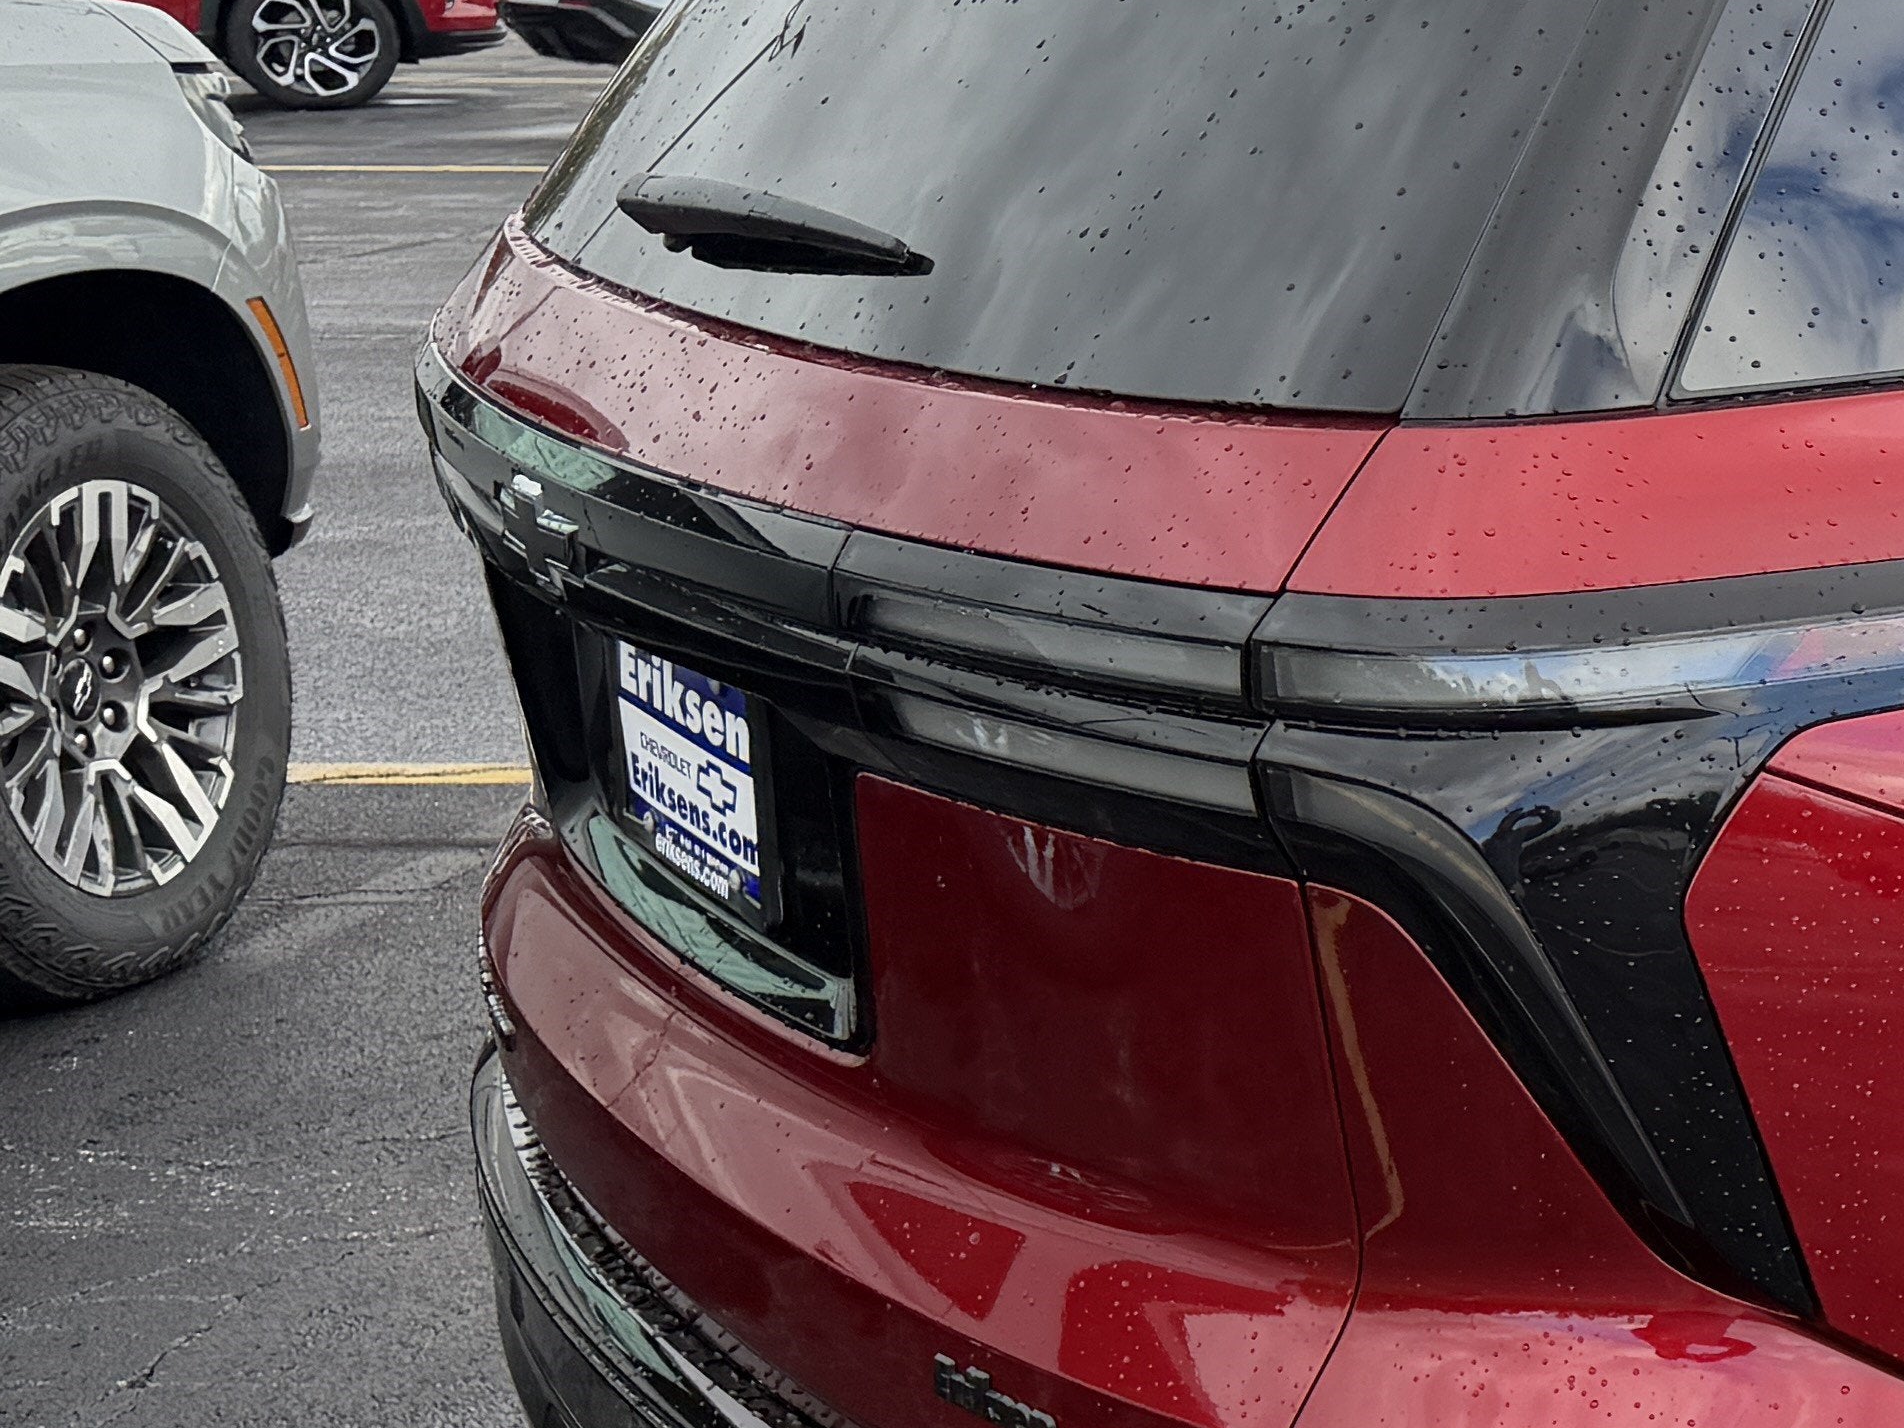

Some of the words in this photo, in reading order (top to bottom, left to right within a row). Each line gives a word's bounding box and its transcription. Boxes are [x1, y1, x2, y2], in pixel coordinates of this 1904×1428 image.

[618, 638, 751, 763] Eriksen
[639, 731, 692, 779] CHEVROLET
[630, 750, 760, 867] Eriksens.com
[654, 831, 730, 900] eriksens.com
